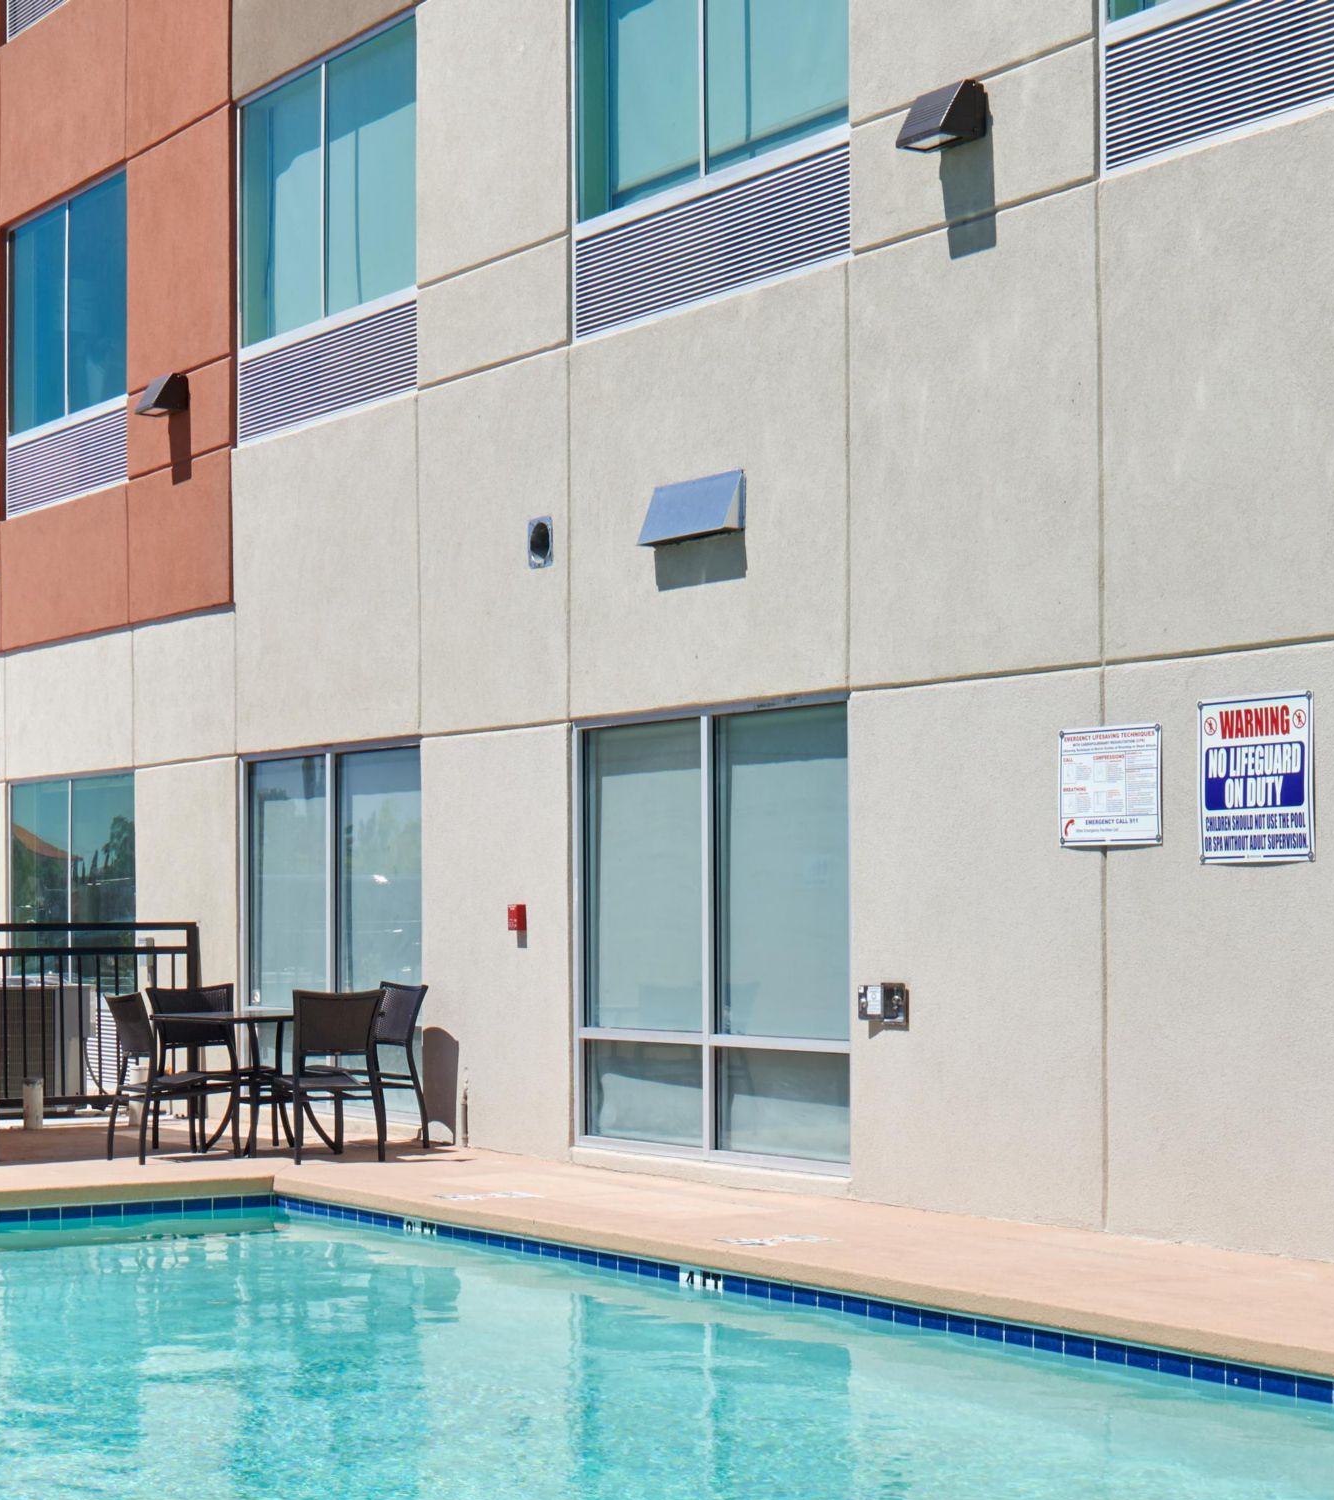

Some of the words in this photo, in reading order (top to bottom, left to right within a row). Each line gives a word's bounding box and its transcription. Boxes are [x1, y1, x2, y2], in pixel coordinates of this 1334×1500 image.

[1219, 705, 1290, 739] WARNING
[1208, 748, 1227, 778] NO
[1229, 743, 1302, 777] LIFEGUARD
[1224, 778, 1244, 808] ON
[1246, 775, 1284, 807] DUTY
[1205, 816, 1231, 832] CHILDREN
[1232, 814, 1253, 831] SHOULD
[1255, 814, 1266, 830] NOT
[1267, 813, 1277, 829] USE
[1279, 813, 1290, 829] THE
[1290, 812, 1306, 828] POOL
[1205, 836, 1212, 852] OR
[1213, 836, 1223, 851] SPA
[1224, 835, 1248, 851] WITHOUT
[1249, 834, 1267, 850] ADULT
[1267, 833, 1309, 850] SUPERVISION.
